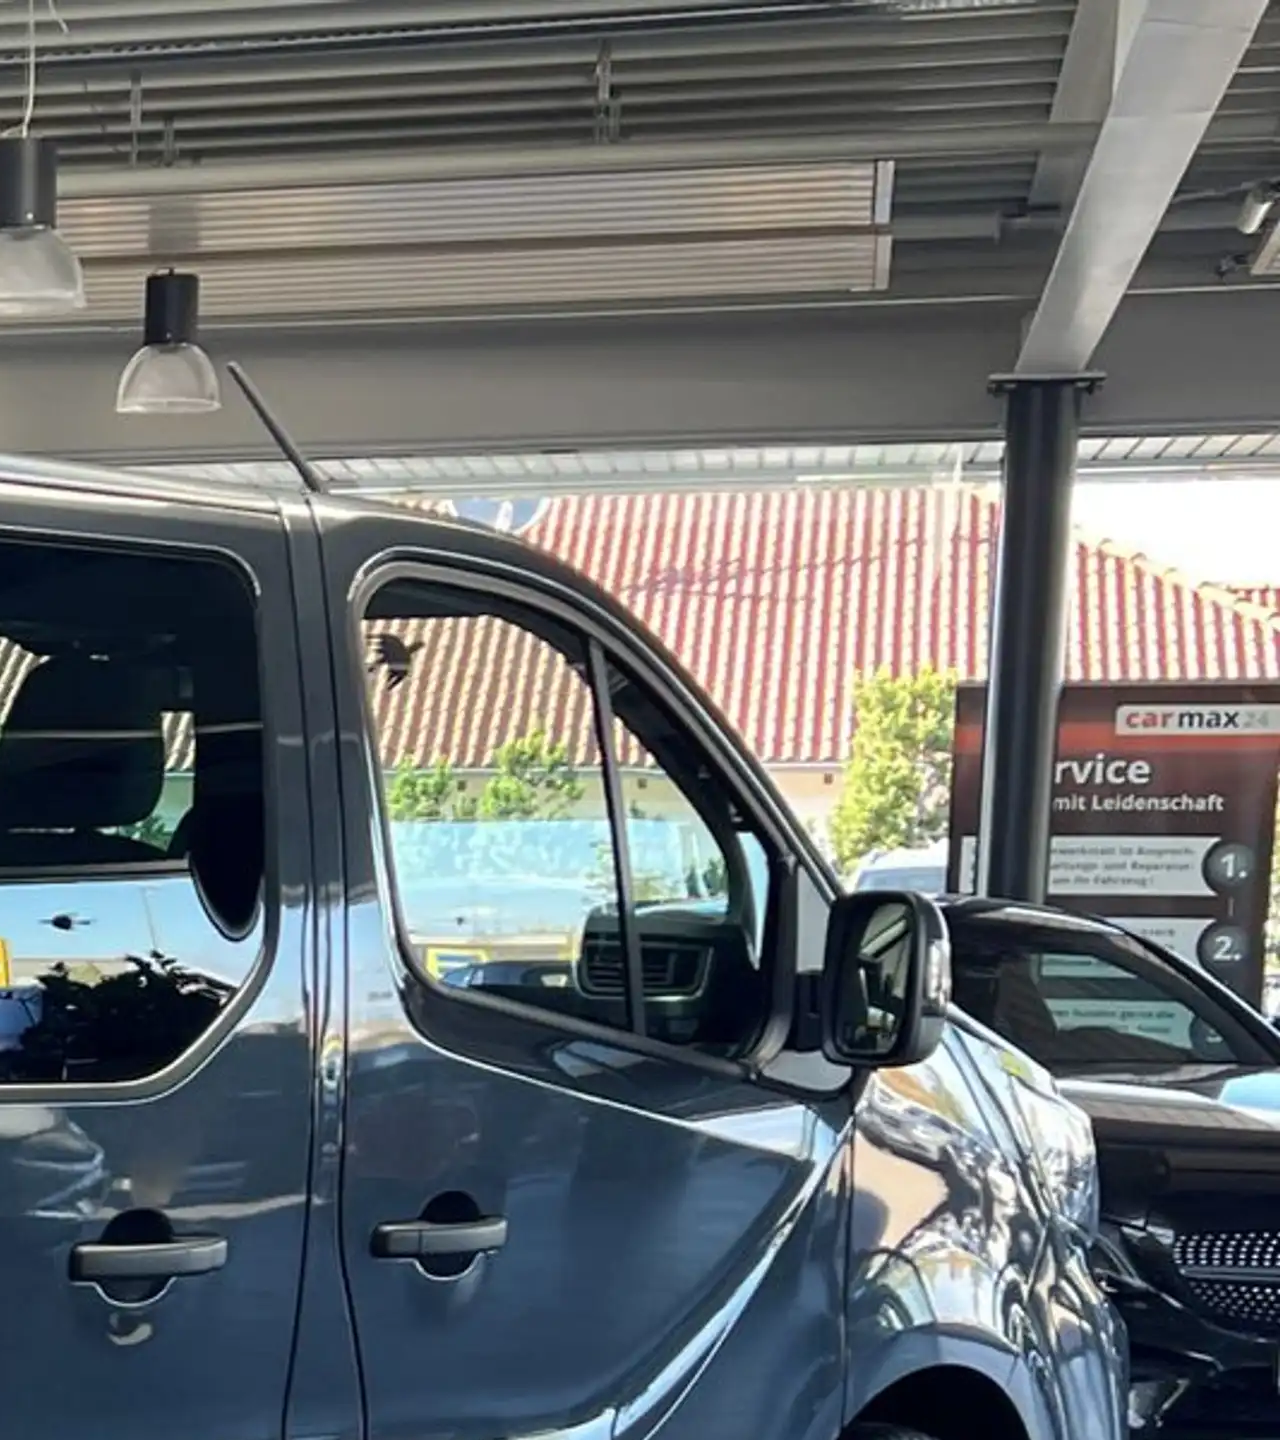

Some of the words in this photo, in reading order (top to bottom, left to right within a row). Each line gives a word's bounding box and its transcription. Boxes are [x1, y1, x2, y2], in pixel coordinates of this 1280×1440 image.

[1053, 752, 1151, 785] rvice
[1052, 793, 1087, 811] mit
[1091, 792, 1224, 812] Leidenschaft
[1219, 853, 1248, 878] 1.
[1212, 935, 1242, 961] 2.
